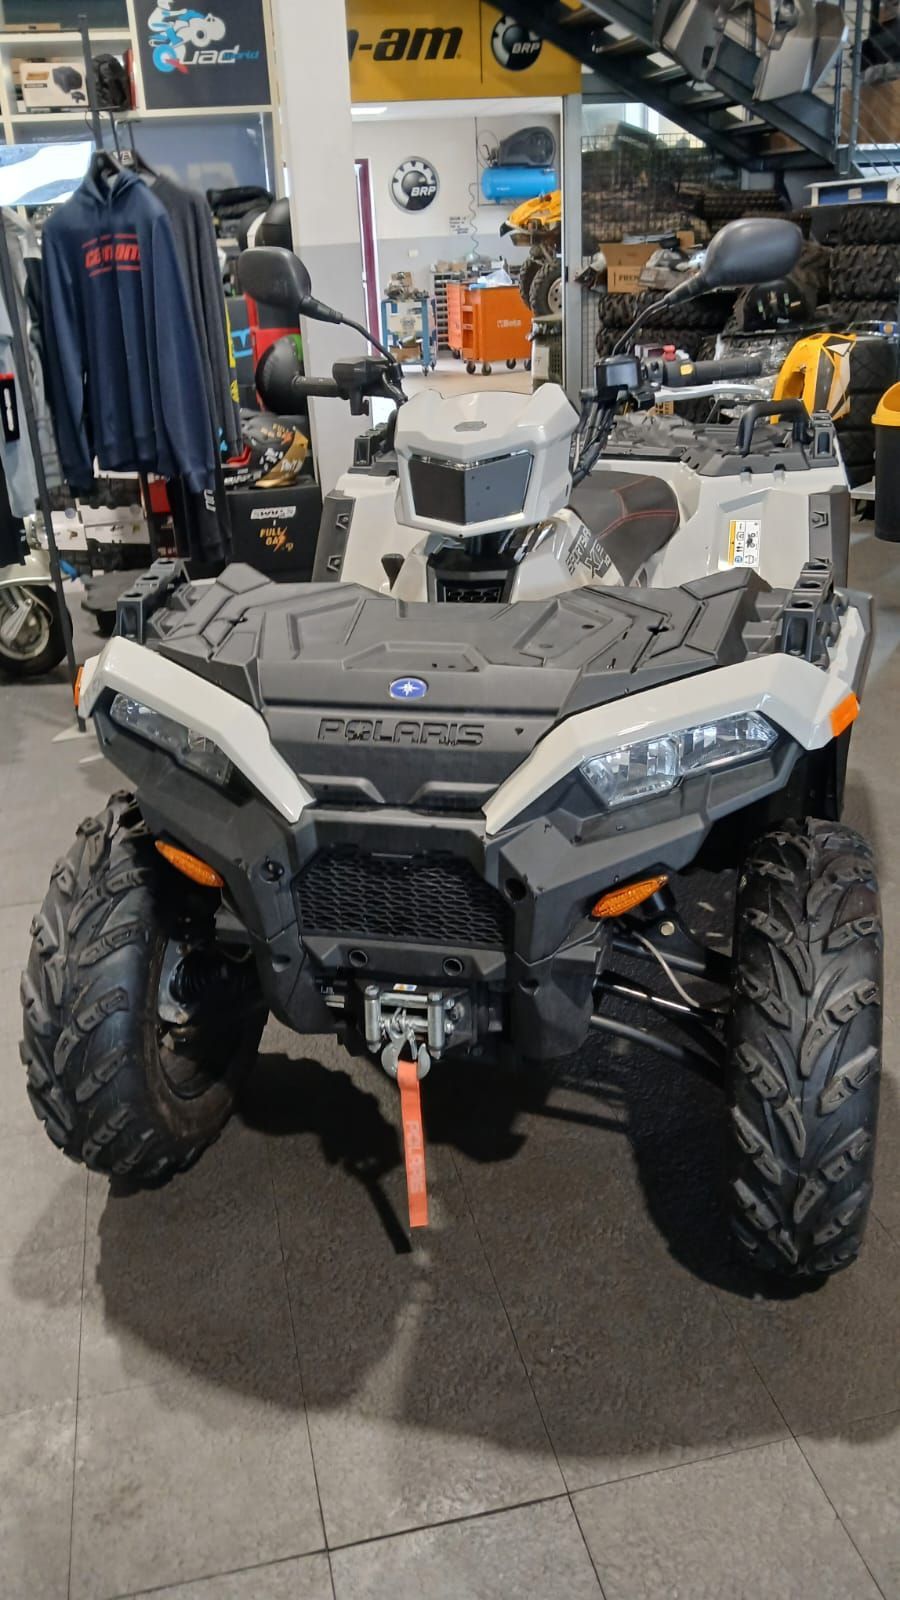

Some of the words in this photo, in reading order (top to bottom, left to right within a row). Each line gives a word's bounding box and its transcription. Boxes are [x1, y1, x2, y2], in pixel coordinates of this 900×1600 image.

[511, 42, 541, 54] BRP
[411, 186, 437, 197] BRP
[85, 243, 141, 269] canam
[318, 718, 485, 746] POLARIS
